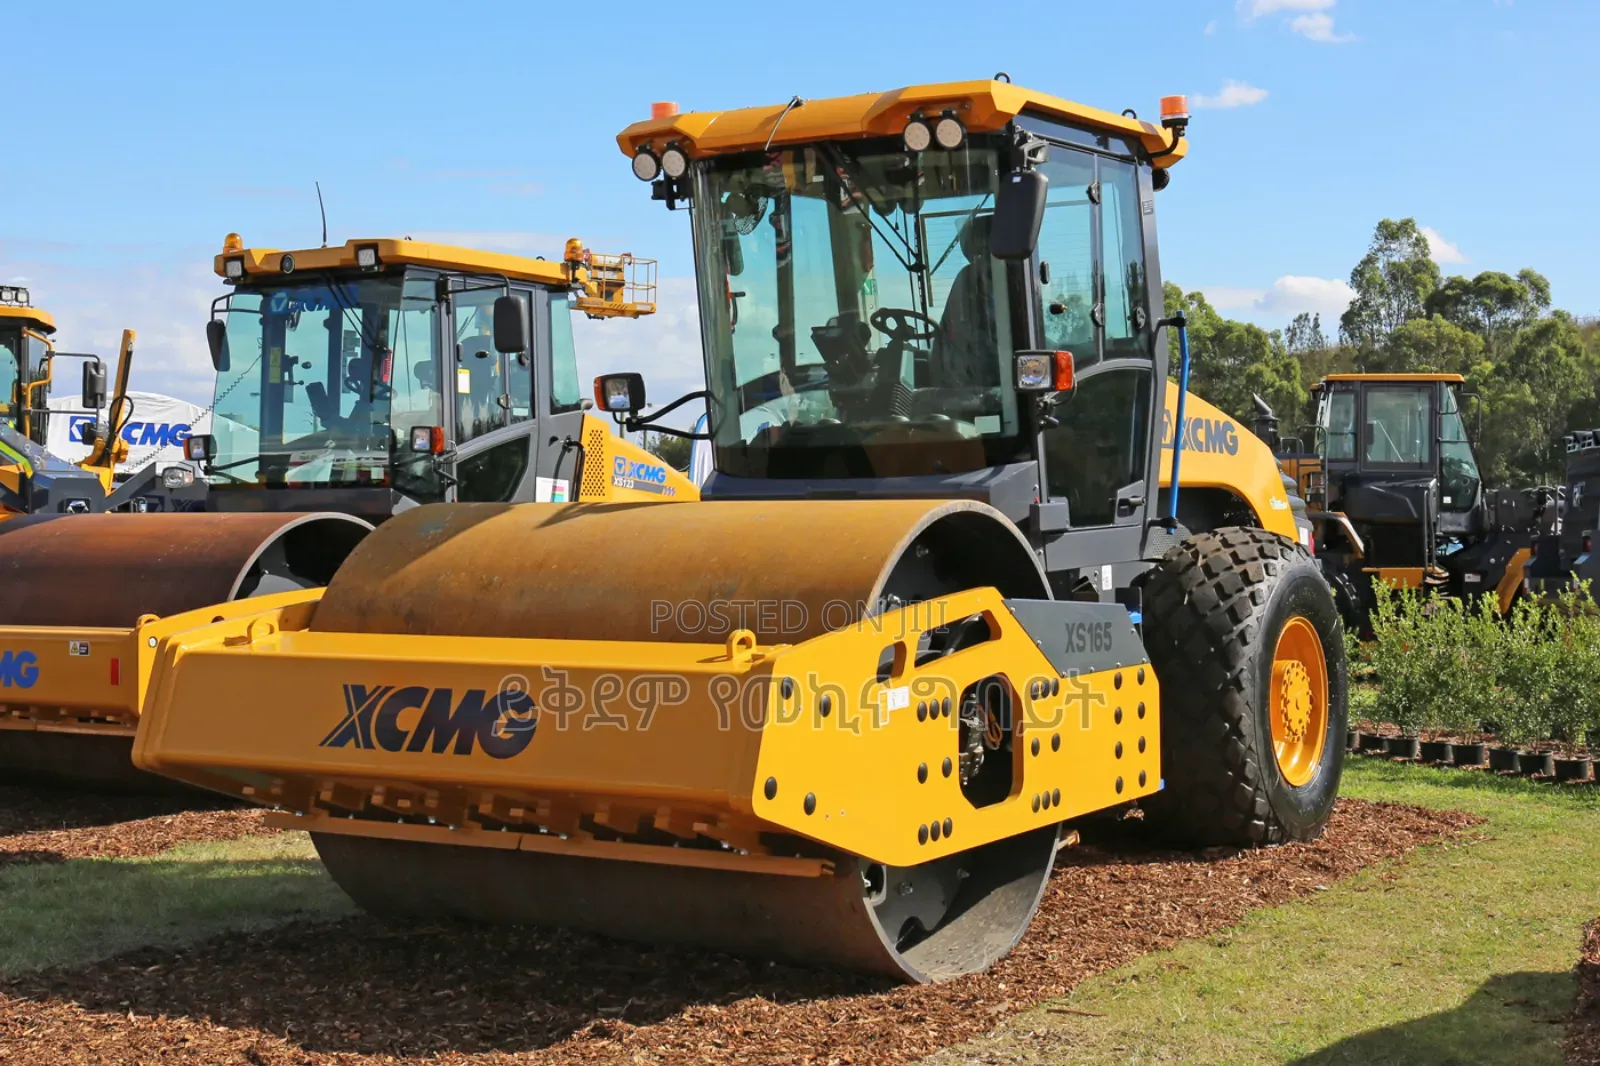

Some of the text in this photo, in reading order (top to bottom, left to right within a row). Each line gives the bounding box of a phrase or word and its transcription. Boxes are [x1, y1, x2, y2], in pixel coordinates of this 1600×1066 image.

[121, 421, 193, 447] CMG
[1180, 416, 1239, 456] XCMG
[628, 461, 666, 484] XCMG
[1064, 621, 1113, 654] XS165
[318, 684, 538, 760] XCMG
